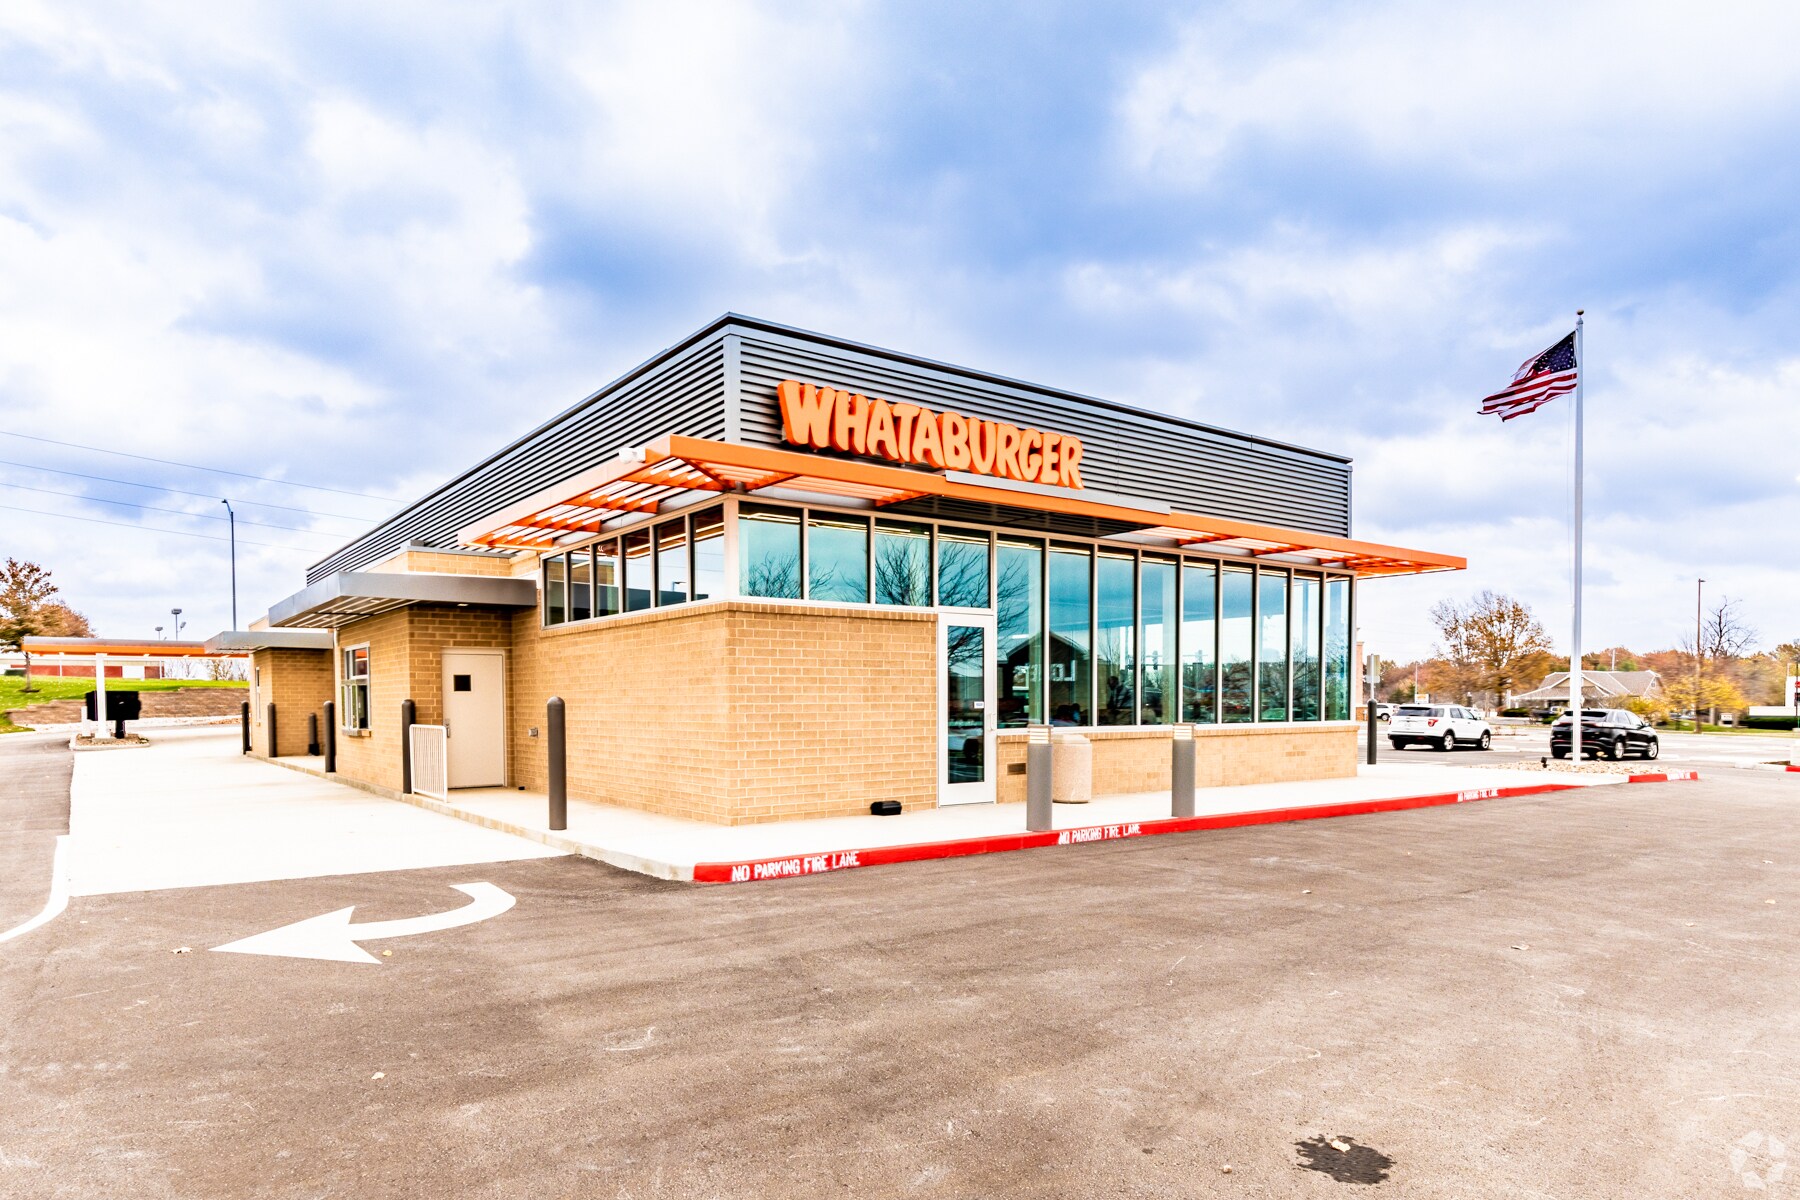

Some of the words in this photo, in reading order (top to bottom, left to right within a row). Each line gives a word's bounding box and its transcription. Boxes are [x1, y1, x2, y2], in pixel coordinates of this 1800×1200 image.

[777, 380, 1084, 489] WHATABURGER
[1058, 832, 1070, 845] NO
[1071, 828, 1102, 843] PARKING
[1104, 825, 1121, 839] FIRE
[1123, 823, 1142, 836] LANE
[731, 865, 750, 882] NO
[754, 859, 800, 878] PARKING
[803, 855, 829, 873] FIRE
[832, 851, 860, 869] LANE
